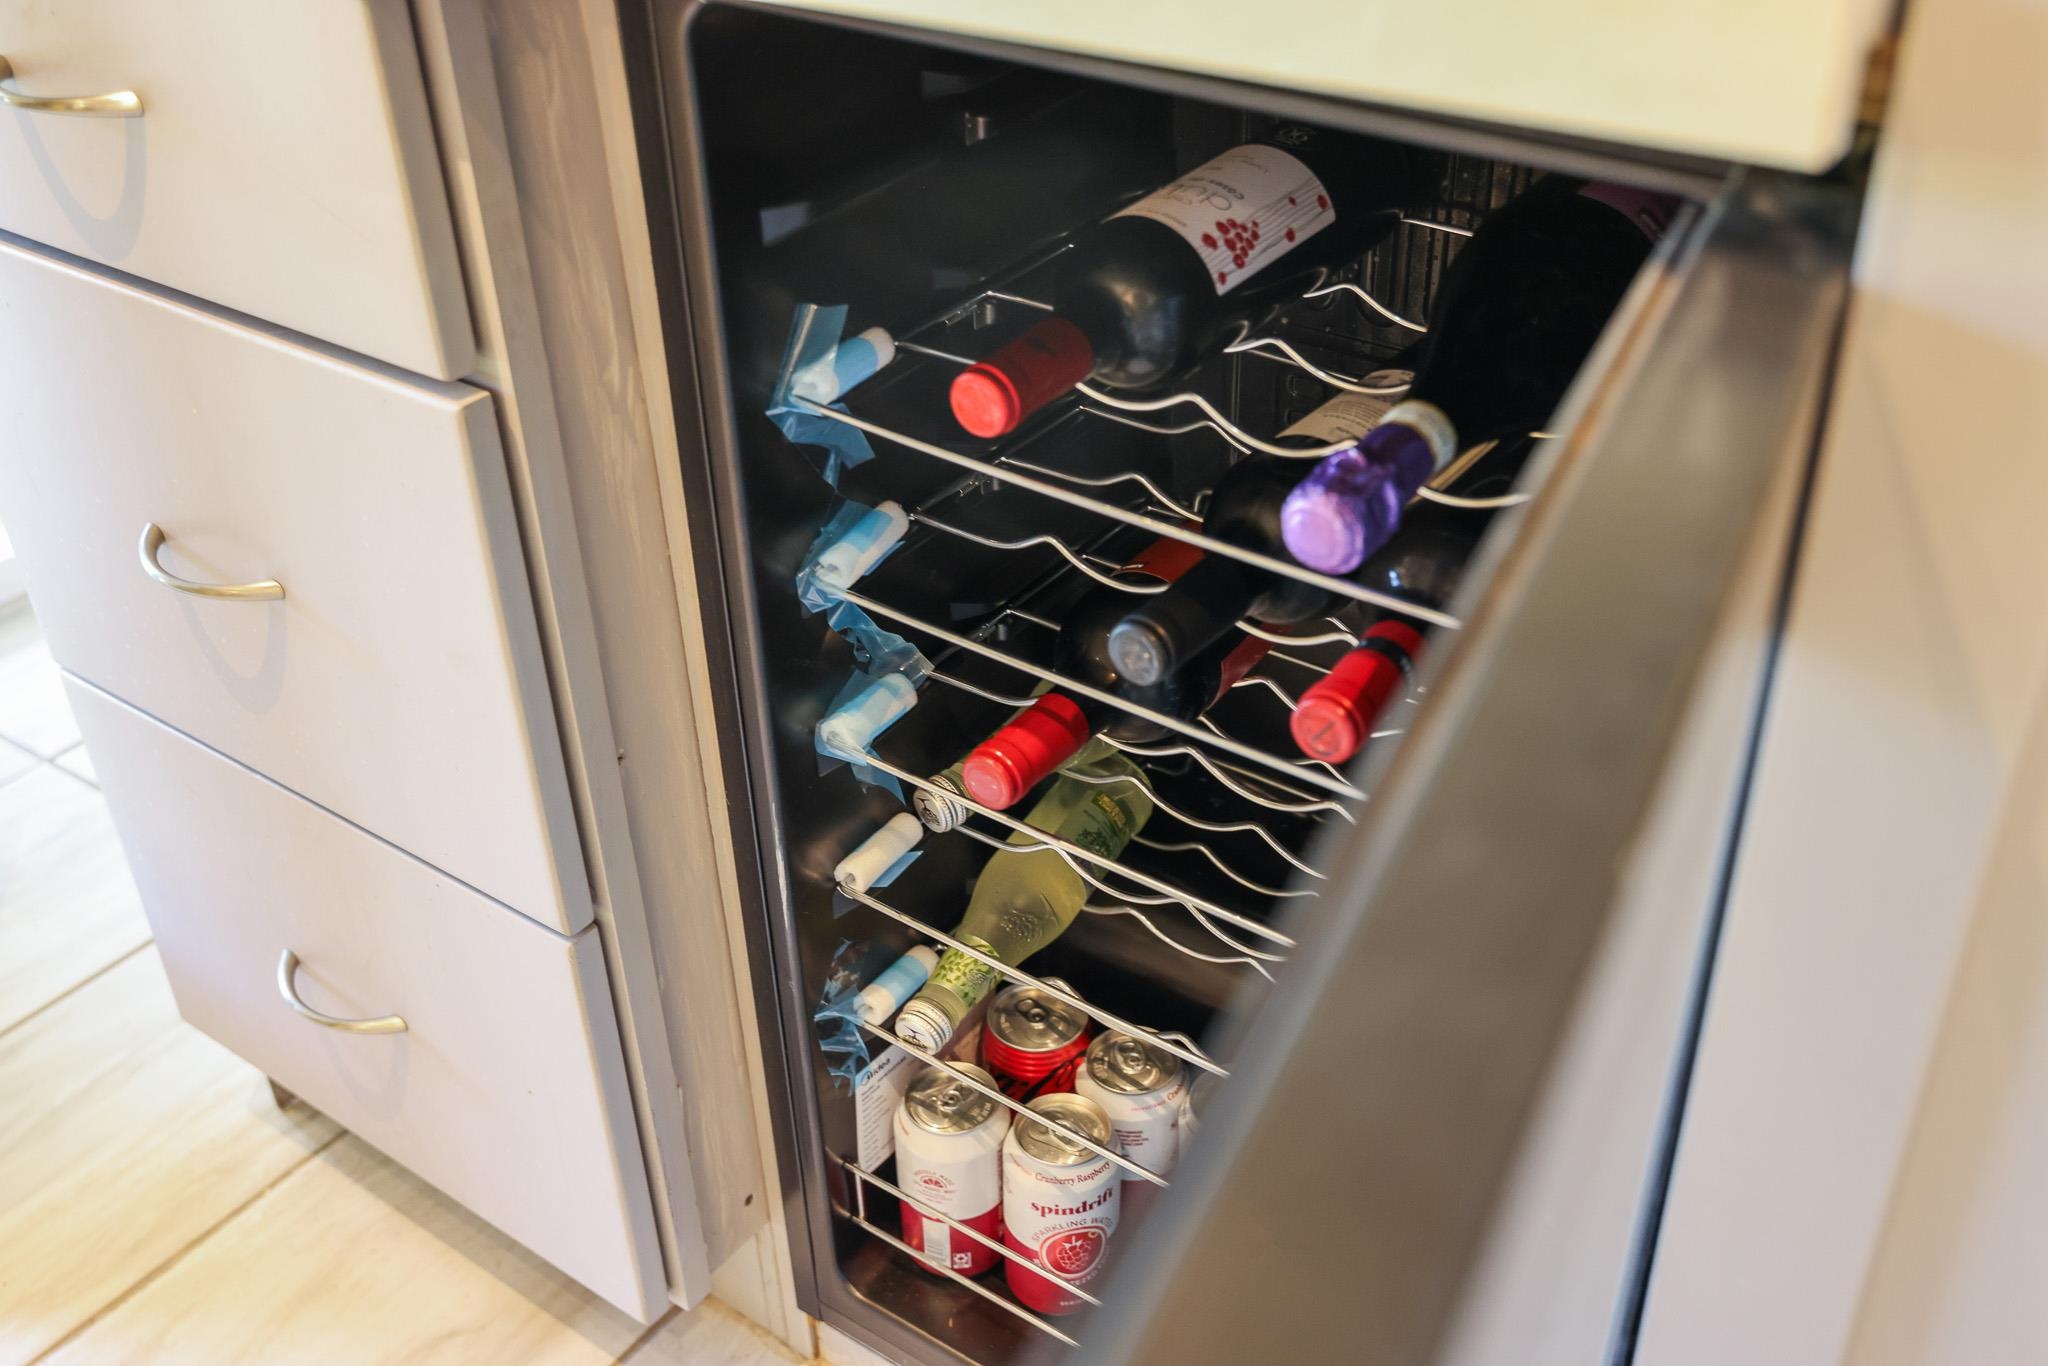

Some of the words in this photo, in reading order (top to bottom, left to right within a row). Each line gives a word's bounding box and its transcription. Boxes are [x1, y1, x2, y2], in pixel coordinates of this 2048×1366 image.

[1034, 1172, 1075, 1186] Cranberry
[1076, 1161, 1110, 1182] Raspberry
[1031, 1187, 1113, 1217] spindrift
[1031, 1219, 1087, 1241] SPARKLING
